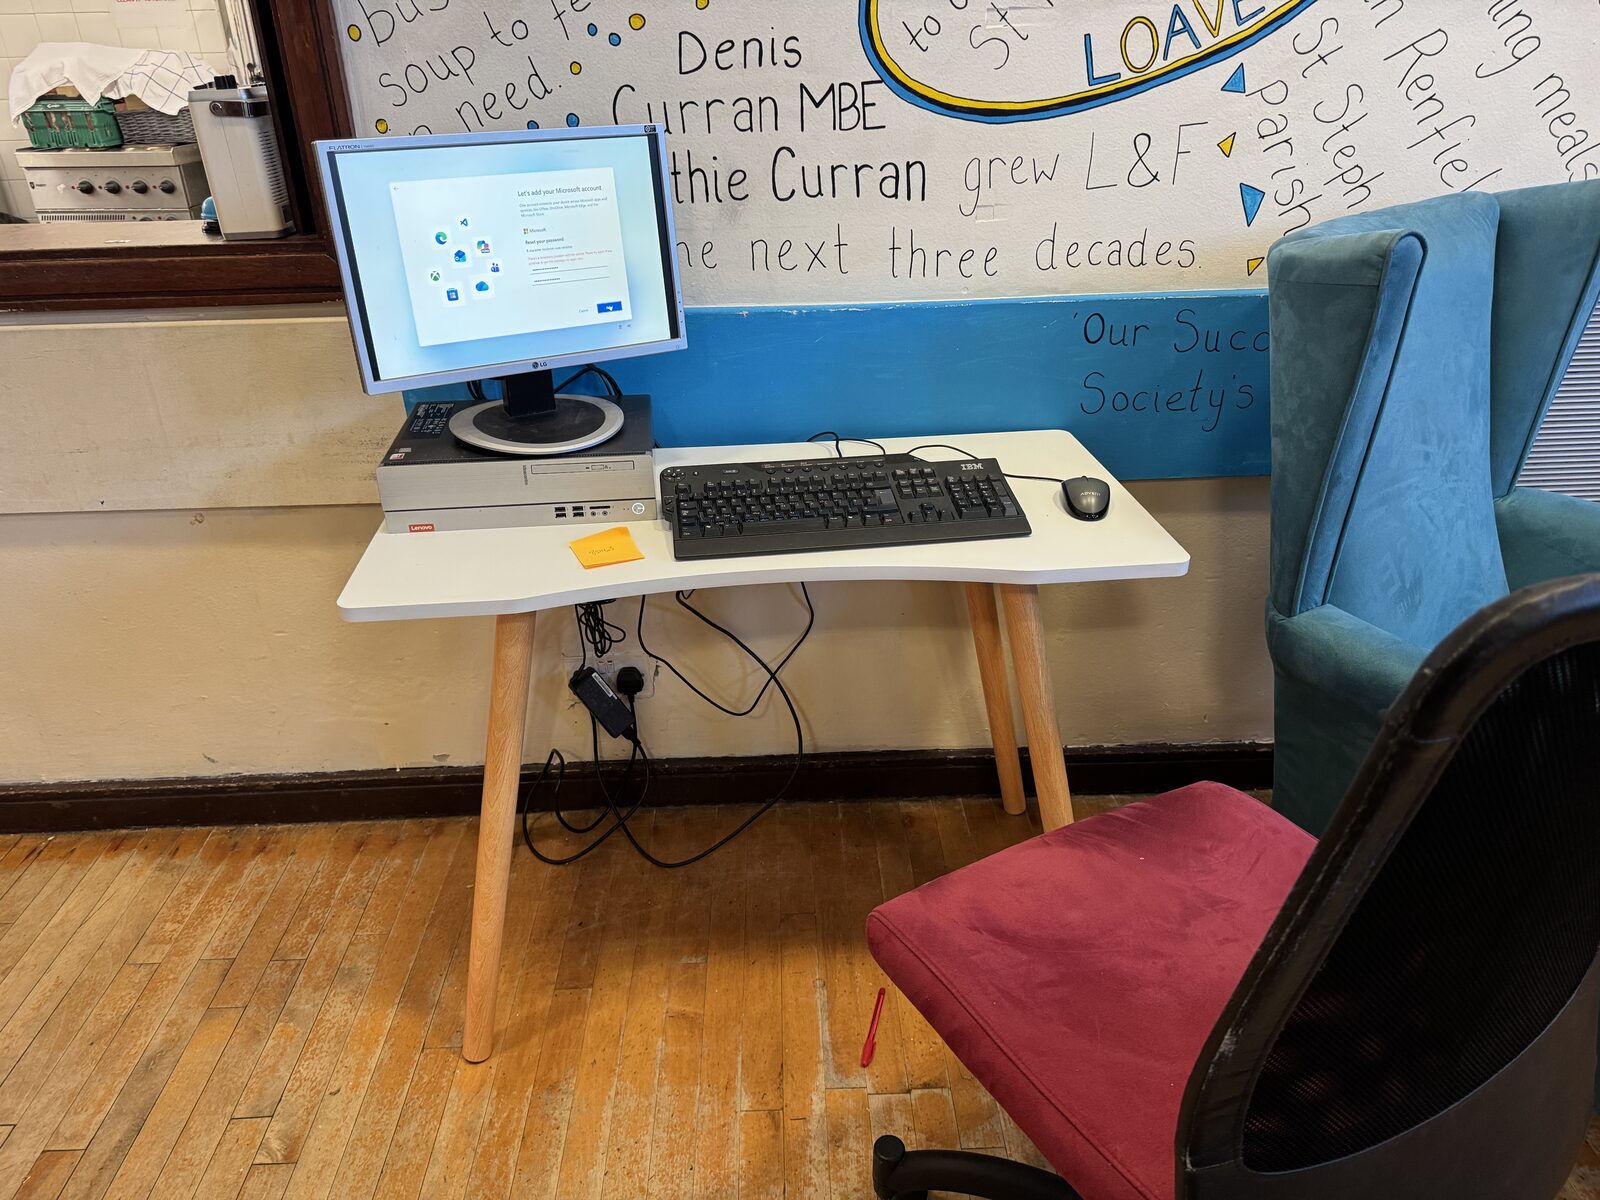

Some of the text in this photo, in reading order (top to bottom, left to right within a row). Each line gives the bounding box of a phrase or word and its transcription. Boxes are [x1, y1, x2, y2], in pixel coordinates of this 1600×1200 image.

[483, 11, 529, 46] to
[678, 27, 802, 75] Denis
[902, 15, 941, 52] to
[1293, 17, 1344, 79] St
[378, 45, 476, 107] soup
[455, 55, 562, 132] need.
[612, 79, 887, 134] Curran MBE
[1313, 83, 1385, 210] Steph
[542, 189, 555, 197] your
[555, 186, 581, 194] Microsoft
[771, 146, 926, 201] Curran
[958, 153, 1060, 217] grew
[750, 223, 849, 275] next
[888, 226, 999, 279] three
[1035, 222, 1202, 271] decades.
[1173, 308, 1270, 353] Succ
[1079, 368, 1255, 433] Society's
[960, 462, 984, 471] IBM
